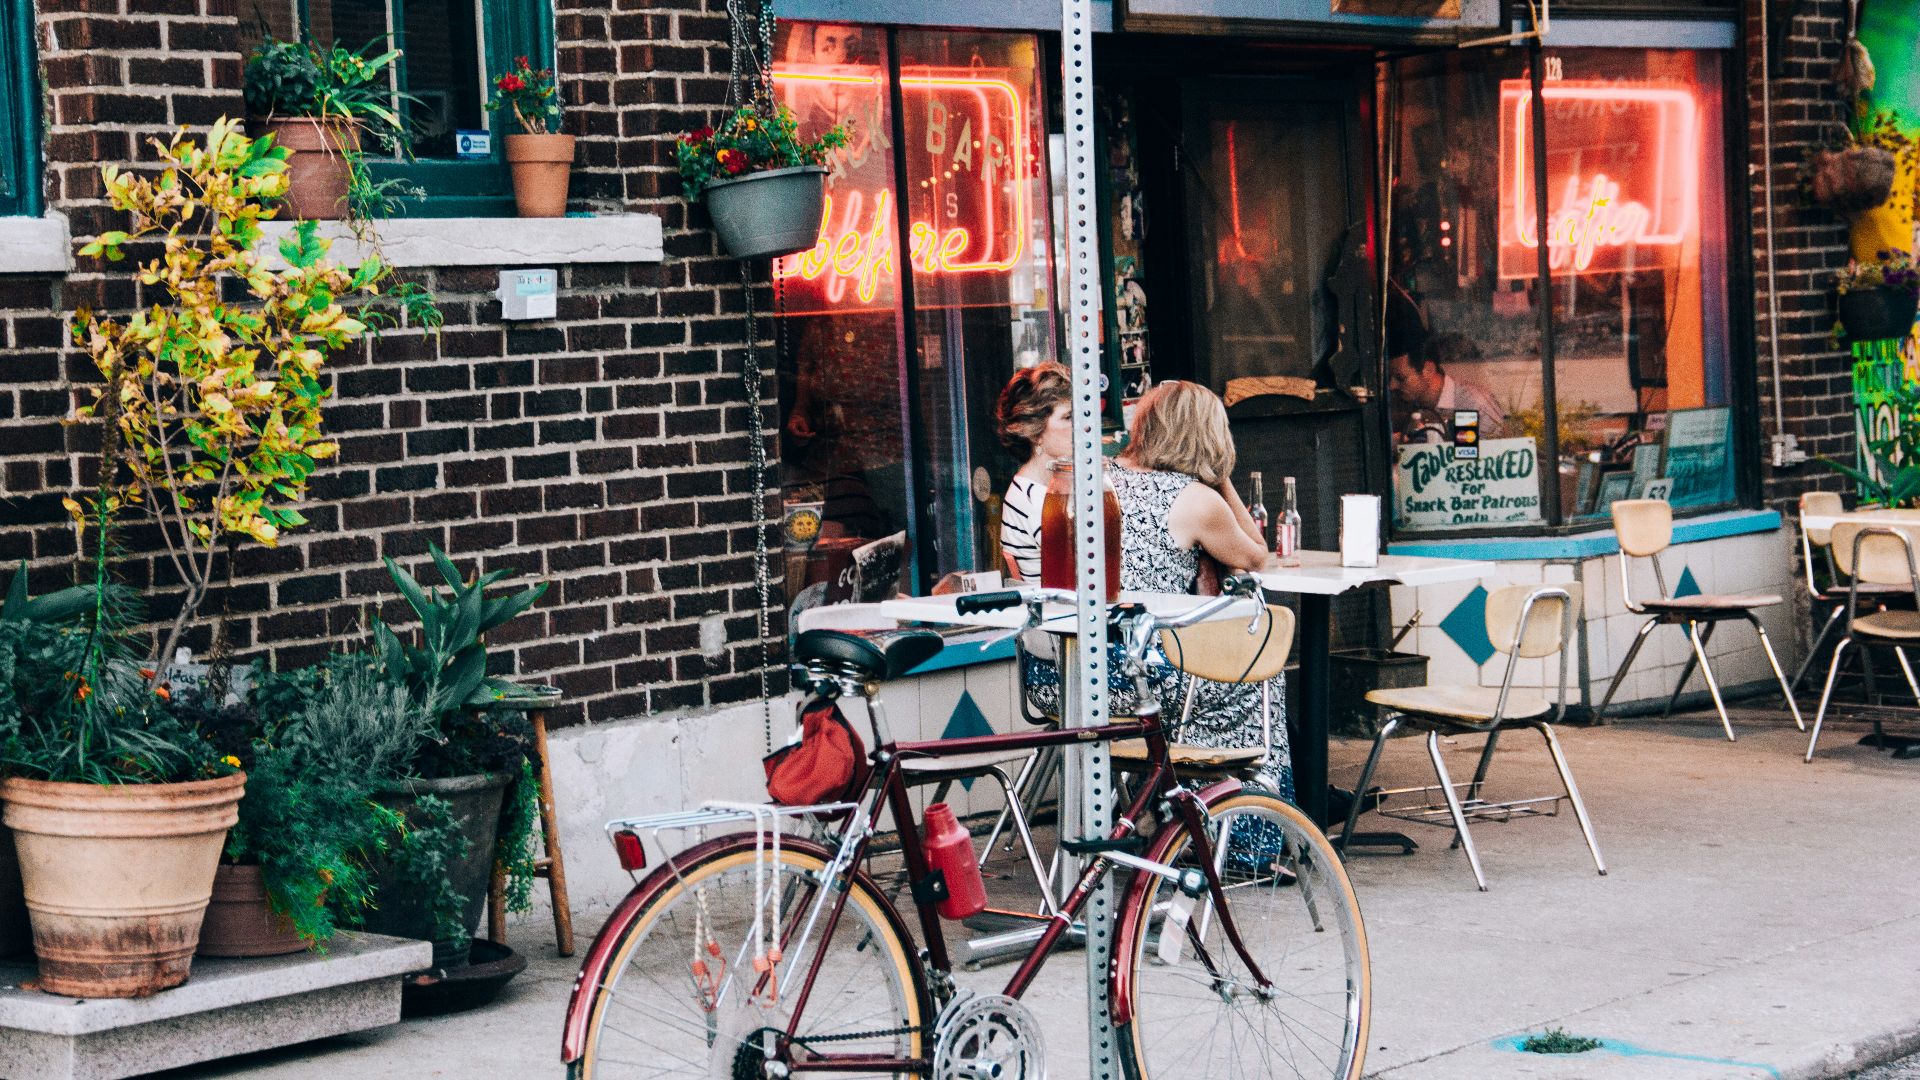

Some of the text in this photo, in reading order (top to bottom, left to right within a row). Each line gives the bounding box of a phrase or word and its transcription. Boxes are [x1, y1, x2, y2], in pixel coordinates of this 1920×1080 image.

[1544, 57, 1563, 81] 128
[926, 100, 1004, 185] BAR
[1401, 444, 1454, 494] Table
[1445, 448, 1533, 483] RESERVED
[1405, 495, 1538, 513] Snack Bar Patrons
